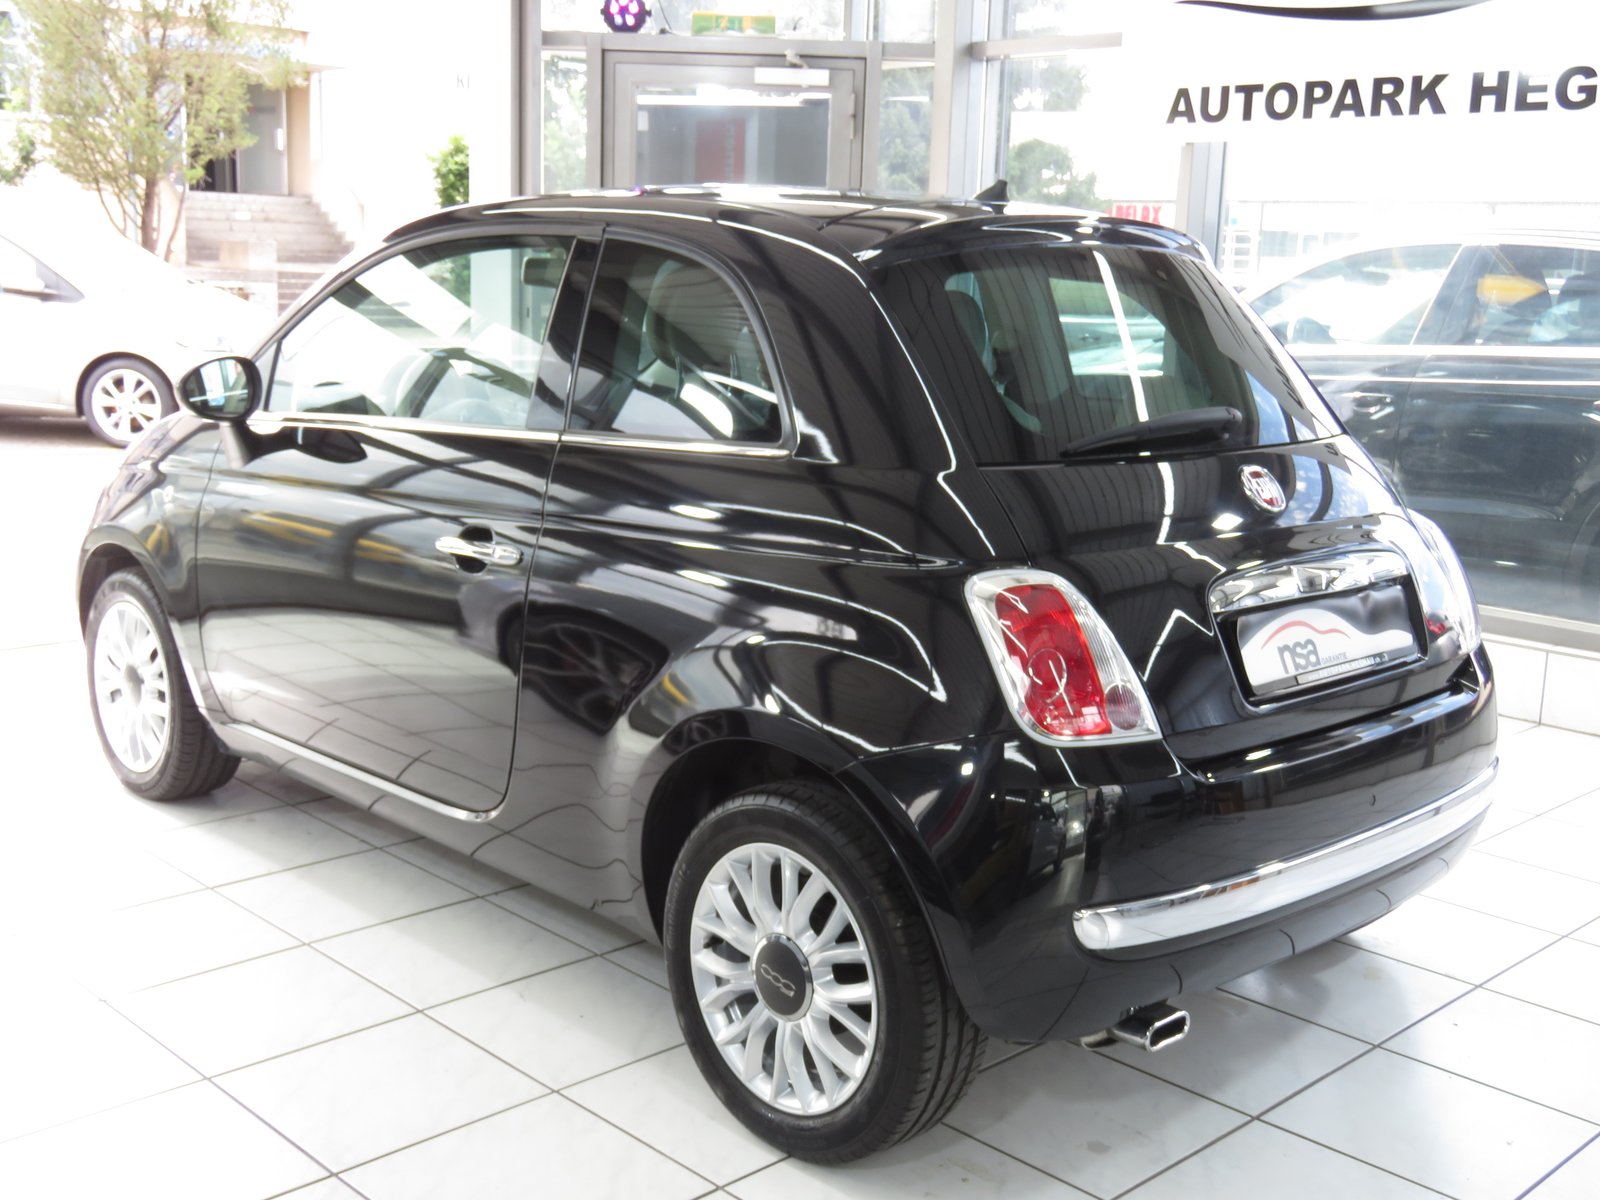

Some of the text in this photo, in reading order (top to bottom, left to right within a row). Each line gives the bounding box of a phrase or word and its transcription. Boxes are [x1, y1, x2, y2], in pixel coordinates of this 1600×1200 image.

[1166, 65, 1598, 124] AUTOPARK HEG
[1276, 637, 1321, 675] nsa
